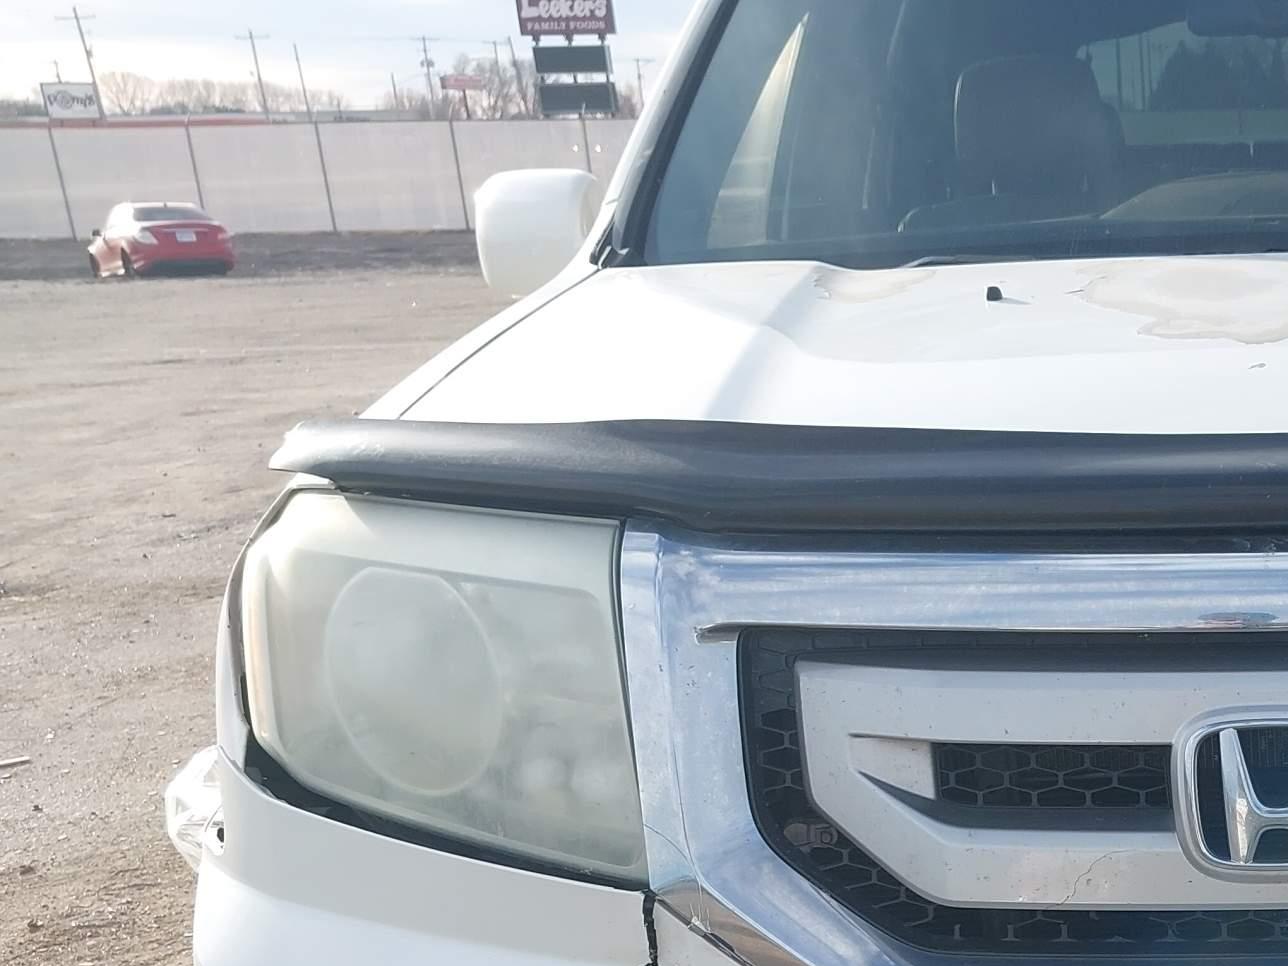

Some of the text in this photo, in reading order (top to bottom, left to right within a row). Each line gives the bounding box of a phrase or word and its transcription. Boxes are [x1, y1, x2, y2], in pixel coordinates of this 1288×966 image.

[521, 0, 607, 18] Leekers
[527, 21, 605, 31] FAMILY FOODS
